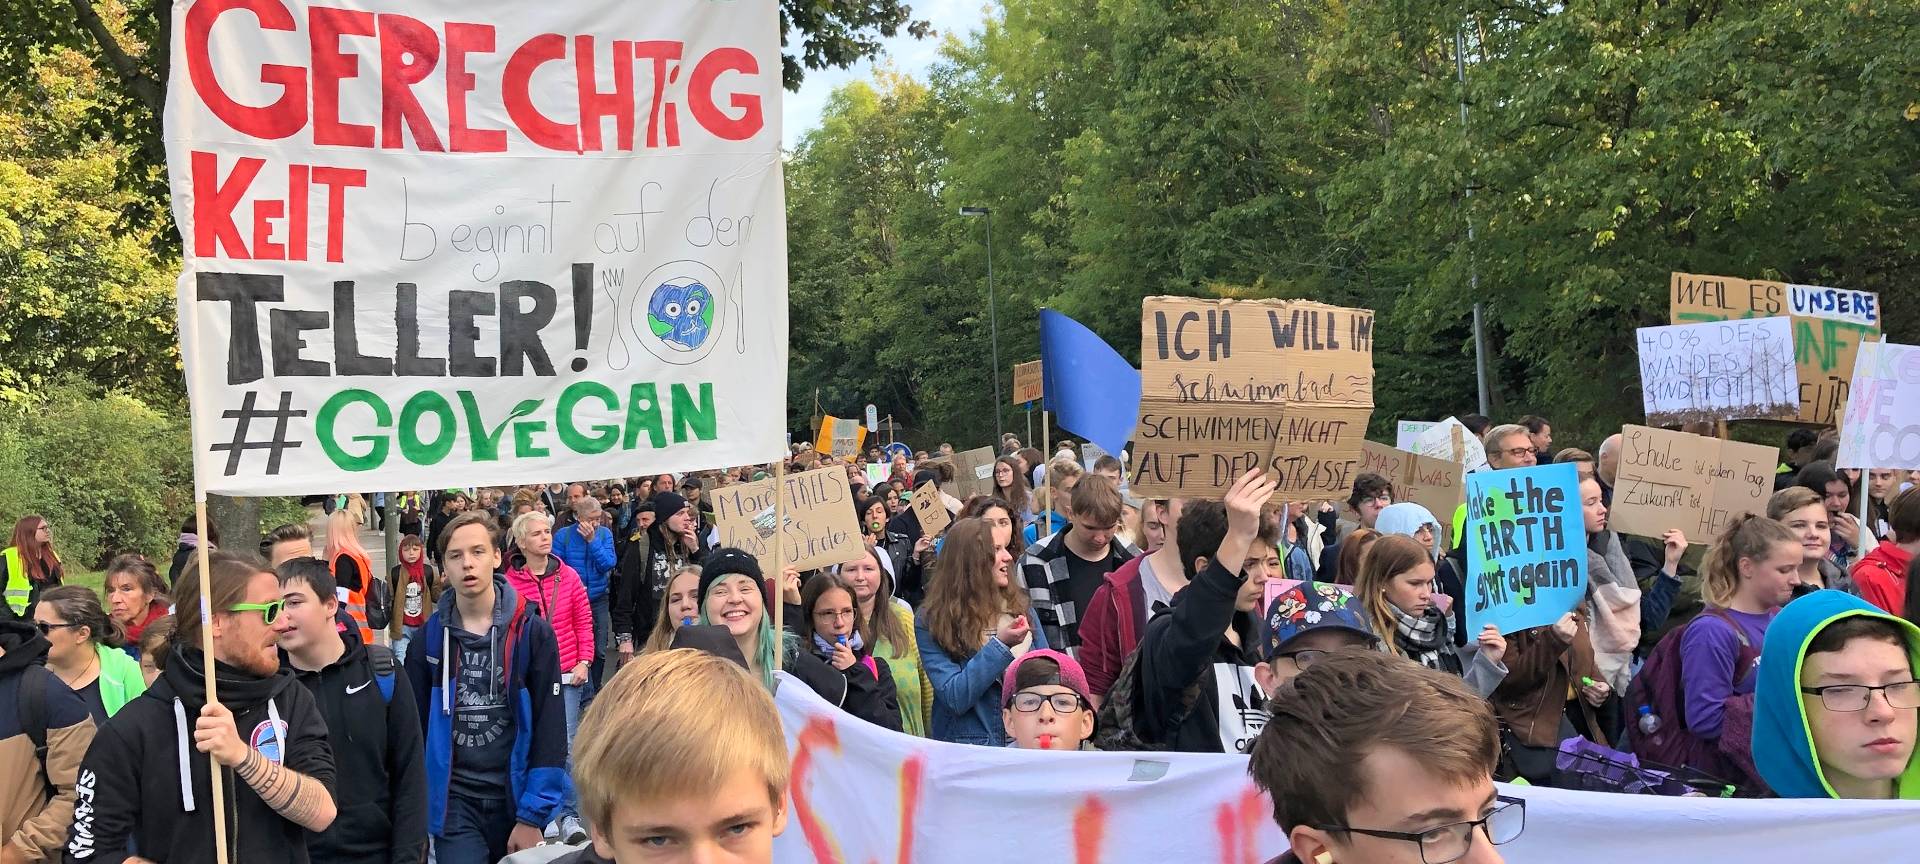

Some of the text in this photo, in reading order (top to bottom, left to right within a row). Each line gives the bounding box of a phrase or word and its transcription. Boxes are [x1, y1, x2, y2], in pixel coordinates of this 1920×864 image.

[401, 177, 572, 282] beginnt
[594, 181, 665, 254] auf
[1677, 276, 1878, 321] WEIL ES UNSERE
[195, 262, 595, 385] TELLER!
[1155, 309, 1373, 362] ICH WILL IM
[1719, 322, 1771, 345] DES
[1641, 352, 1738, 378] WALDES
[1645, 376, 1744, 403] SIND TOT
[1288, 416, 1348, 446] NICHT
[1134, 451, 1200, 489] AUF
[1271, 455, 1357, 491] STRASSE
[1418, 464, 1452, 487] WAS
[1625, 430, 1682, 471] Schule
[1695, 460, 1704, 475] ist
[1705, 462, 1735, 485] jeden
[784, 471, 843, 511] TREES
[1505, 477, 1565, 515] the
[1623, 473, 1701, 509] Zukunft ist
[1479, 516, 1565, 561] EARTH
[1508, 558, 1579, 605] again
